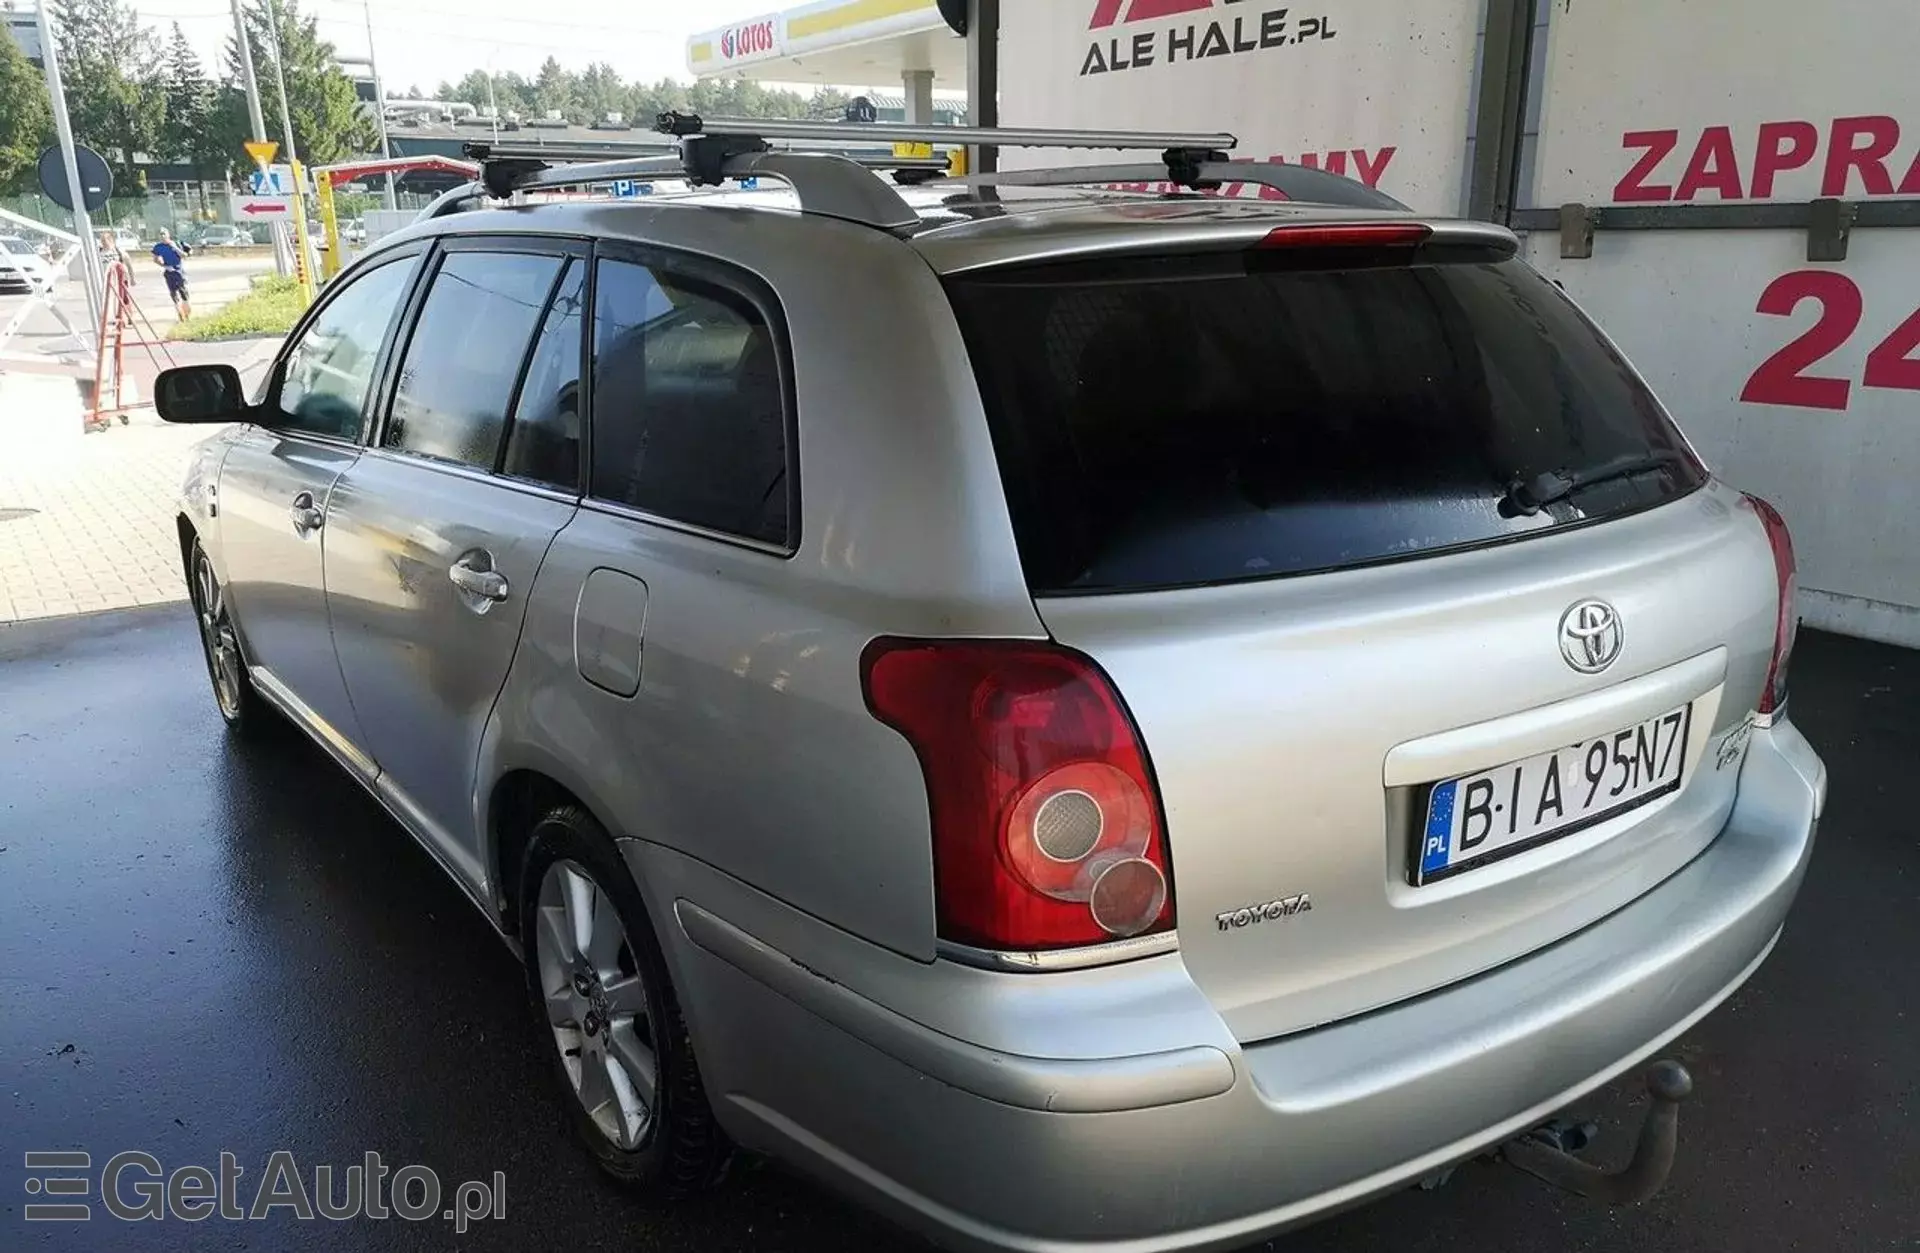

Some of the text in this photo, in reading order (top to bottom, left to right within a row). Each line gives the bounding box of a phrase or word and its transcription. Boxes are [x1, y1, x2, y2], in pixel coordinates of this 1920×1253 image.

[736, 20, 773, 56] LOTOS
[1080, 8, 1337, 76] ALE HALE.PL
[1426, 837, 1447, 857] PL
[1215, 893, 1312, 931] TOYOTA
